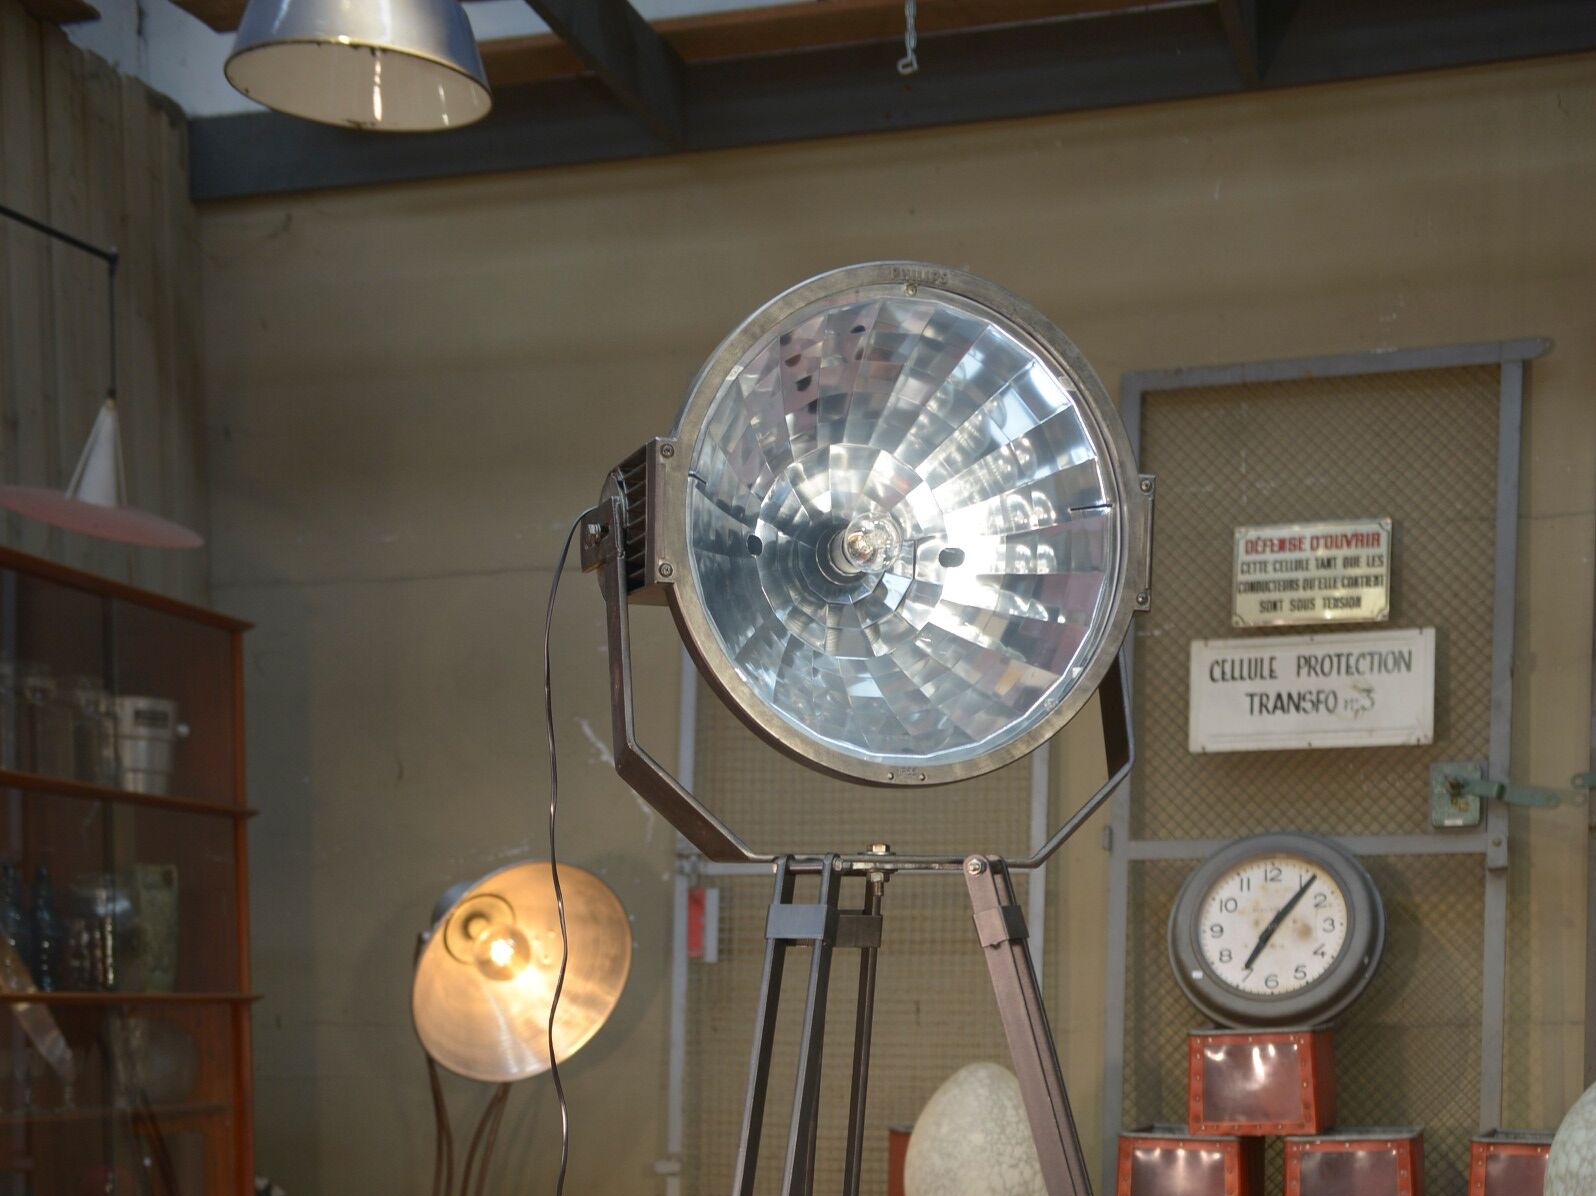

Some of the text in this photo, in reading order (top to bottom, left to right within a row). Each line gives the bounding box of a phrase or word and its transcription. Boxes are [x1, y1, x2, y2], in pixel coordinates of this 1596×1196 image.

[1241, 554, 1384, 575] CETTE CELLULE TANT QUE LES
[1238, 579, 1300, 595] CONDUCTEURS
[1341, 574, 1384, 589] CONTIENT
[1259, 595, 1362, 613] SONT SOUS TENSION
[1209, 648, 1412, 683] CELLULE PROTECTION
[1245, 689, 1338, 716] TRANSFO
[1264, 867, 1282, 883] 12
[1239, 877, 1250, 892] 11
[1219, 897, 1238, 913] 10
[1313, 893, 1327, 909] 2
[1210, 923, 1224, 939] 9
[1323, 917, 1336, 933] 3
[1219, 948, 1233, 964] 8
[1313, 943, 1327, 959] 4
[1294, 965, 1307, 980] 5
[1264, 973, 1279, 989] 6
